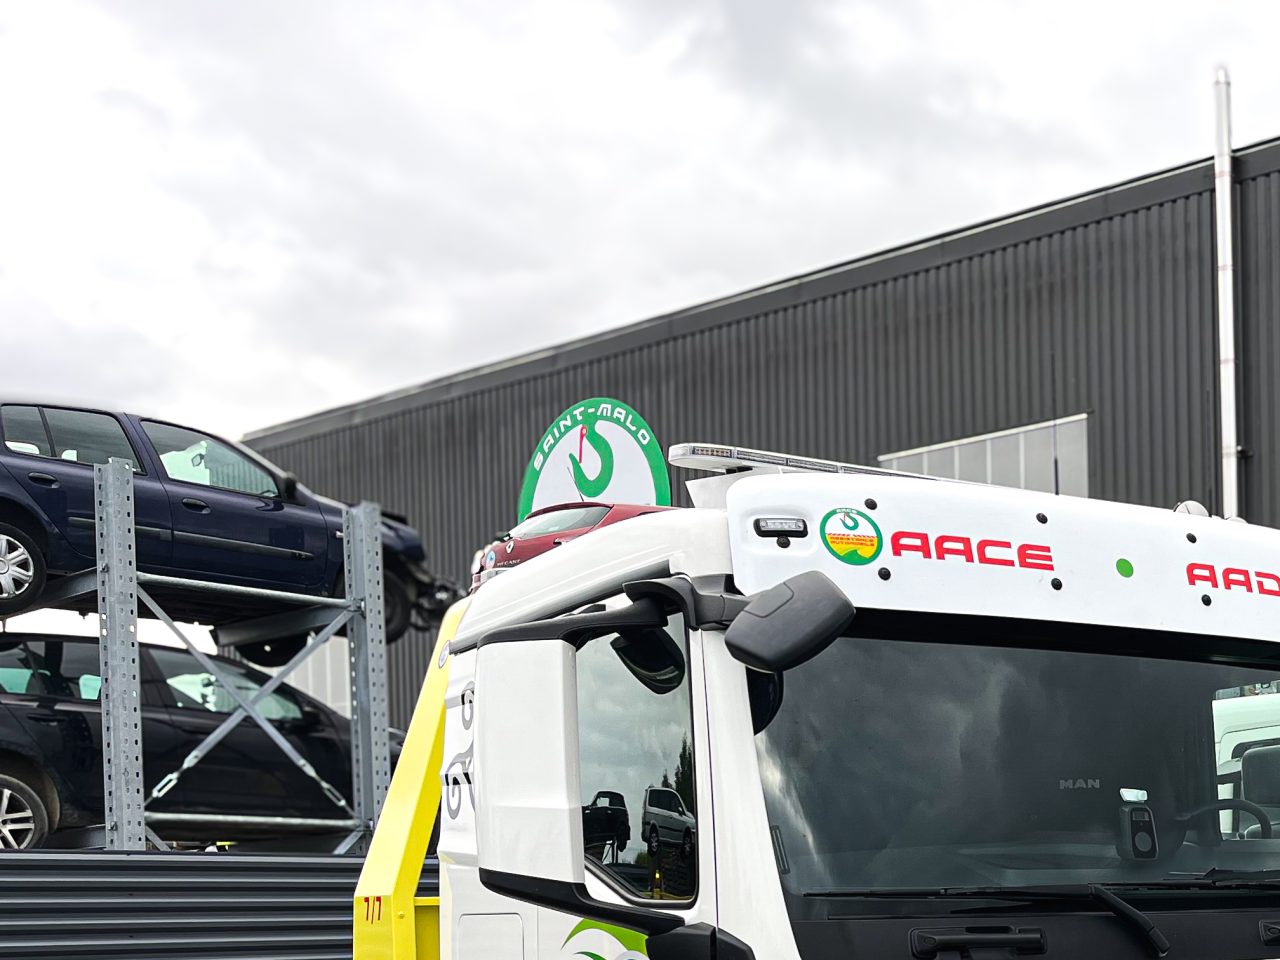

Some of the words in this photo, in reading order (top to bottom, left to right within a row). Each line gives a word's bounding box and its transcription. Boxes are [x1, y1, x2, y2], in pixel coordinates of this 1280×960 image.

[533, 403, 651, 472] SAINT-MALO
[890, 530, 1055, 572] AACE
[1059, 779, 1100, 790] MAN
[363, 896, 382, 925] 7/7
